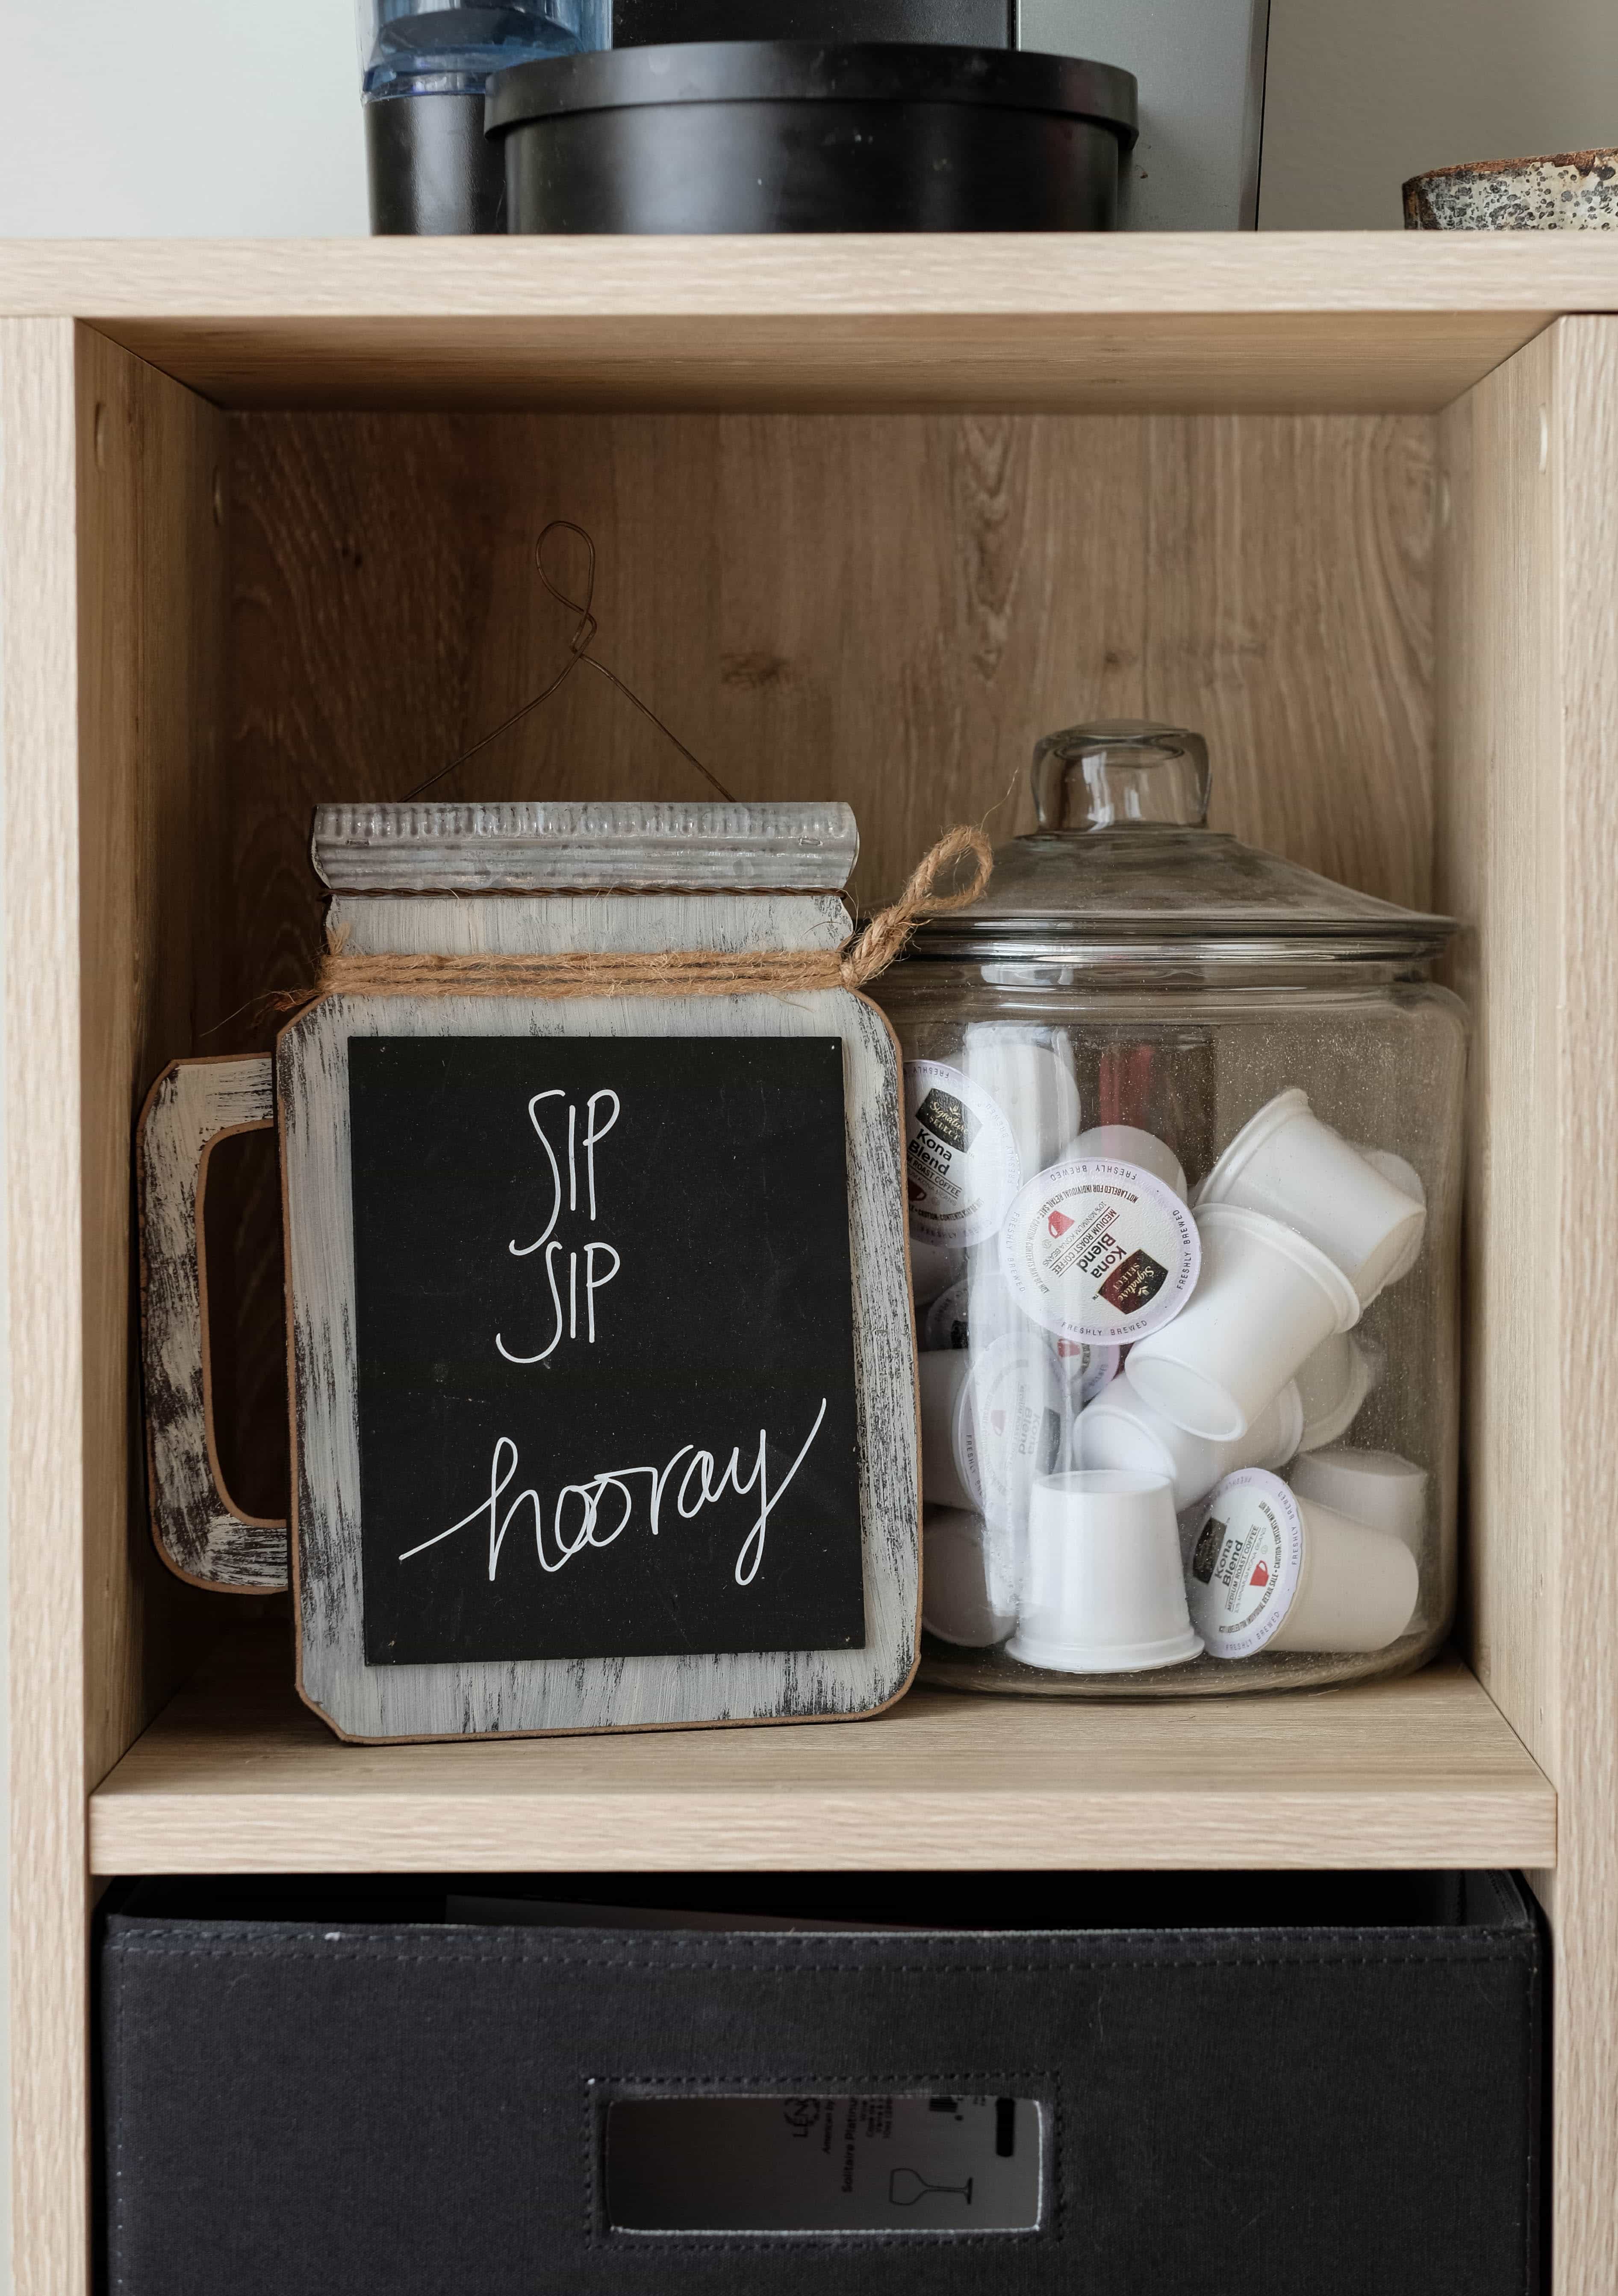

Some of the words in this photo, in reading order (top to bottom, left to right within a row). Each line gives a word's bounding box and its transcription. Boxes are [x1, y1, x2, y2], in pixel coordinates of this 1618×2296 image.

[914, 1067, 949, 1078] FRESHLY
[929, 1115, 961, 1140] SELECT
[930, 1101, 969, 1134] Signature
[908, 1139, 950, 1176] Blend
[917, 1128, 952, 1161] Kona
[509, 1089, 620, 1256] SIP
[913, 1160, 935, 1178] ROAST
[935, 1176, 961, 1197] COFFEE
[1050, 1165, 1087, 1181] BREWED
[1096, 1164, 1137, 1180] FRESHLY
[1046, 1193, 1064, 1208] RETAIL
[1065, 1185, 1092, 1198] INDIVIDUAL
[1093, 1184, 1103, 1193] FOR
[1104, 1185, 1128, 1200] LABELED
[1126, 1192, 1139, 1204] NOT
[1039, 1204, 1050, 1218] SALE
[1076, 1211, 1098, 1236] MINIMUM
[1091, 1209, 1117, 1236] MEDIUM
[1005, 1212, 1020, 1249] FRESHLY
[1060, 1232, 1076, 1249] KONA
[1173, 1210, 1191, 1245] BREWED
[1042, 1248, 1061, 1267] BEANS
[1073, 1232, 1094, 1254] ROAST
[1076, 1233, 1117, 1273] Blend
[1008, 1257, 1026, 1292] BREWED
[1052, 1252, 1076, 1275] COFFEE
[1090, 1245, 1128, 1278] Kona
[1177, 1252, 1191, 1290] FRESHLY
[1034, 1277, 1043, 1286] BE
[1039, 1283, 1050, 1294] HOT
[1117, 1266, 1155, 1301] Signature
[496, 1241, 620, 1363] SIP
[1061, 1322, 1102, 1336] FRESHLY
[1111, 1320, 1147, 1335] BREWED
[1018, 1408, 1032, 1455] Blend
[1028, 1413, 1040, 1455] Kona
[966, 1434, 976, 1475] FRESHLY
[399, 1397, 827, 1585] hooray
[1277, 1491, 1295, 1520] BREWED
[1214, 1539, 1233, 1579] Kona
[1222, 1540, 1244, 1587] Blend
[1226, 1581, 1238, 1612] MEDIUM
[1235, 1554, 1247, 1579] ROAST
[1244, 1526, 1258, 1554] COFFEE
[1269, 1573, 1279, 1588] SALE
[1255, 1611, 1280, 1641] BREWED
[841, 2144, 855, 2193] Solitaire
